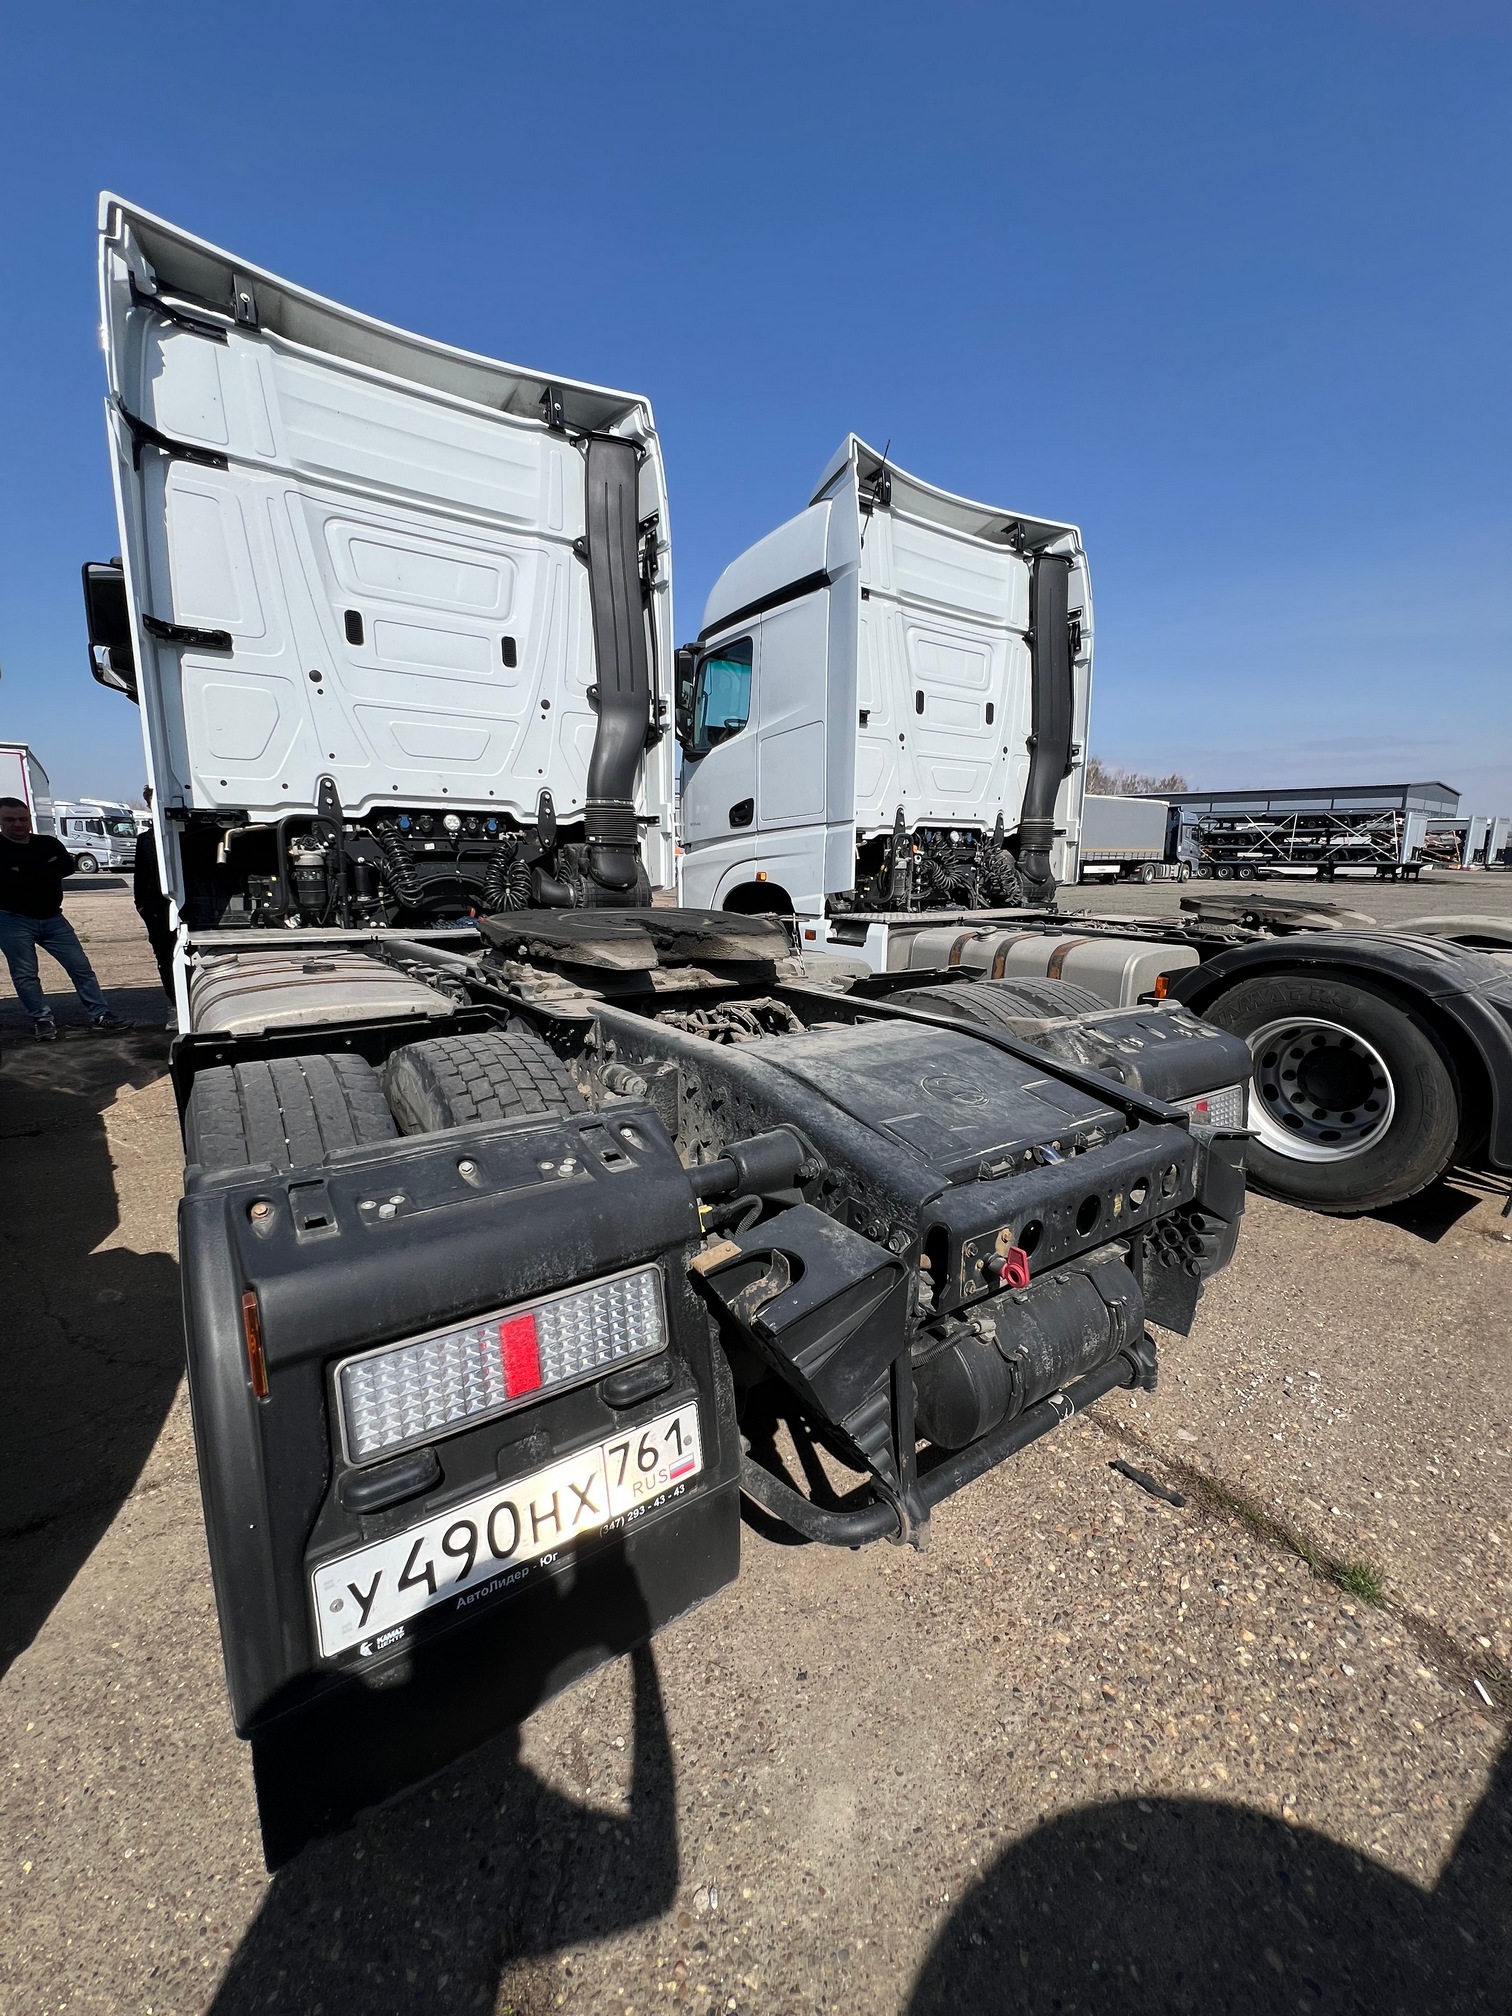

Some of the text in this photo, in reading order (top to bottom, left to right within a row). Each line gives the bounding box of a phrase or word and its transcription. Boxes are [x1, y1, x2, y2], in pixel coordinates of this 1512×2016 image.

[1286, 983, 1359, 1010] PRO
[609, 1417, 683, 1487] 761
[633, 1469, 668, 1498] RUS
[599, 1517, 625, 1538] (347)
[627, 1505, 646, 1522] 293
[653, 1494, 666, 1507] 43
[673, 1484, 686, 1497] 43
[456, 1566, 530, 1610] АвтоЛидер
[540, 1551, 559, 1568] Юг
[376, 1626, 405, 1644] KAMAZ
[377, 1632, 406, 1650] ЦЕНТР
